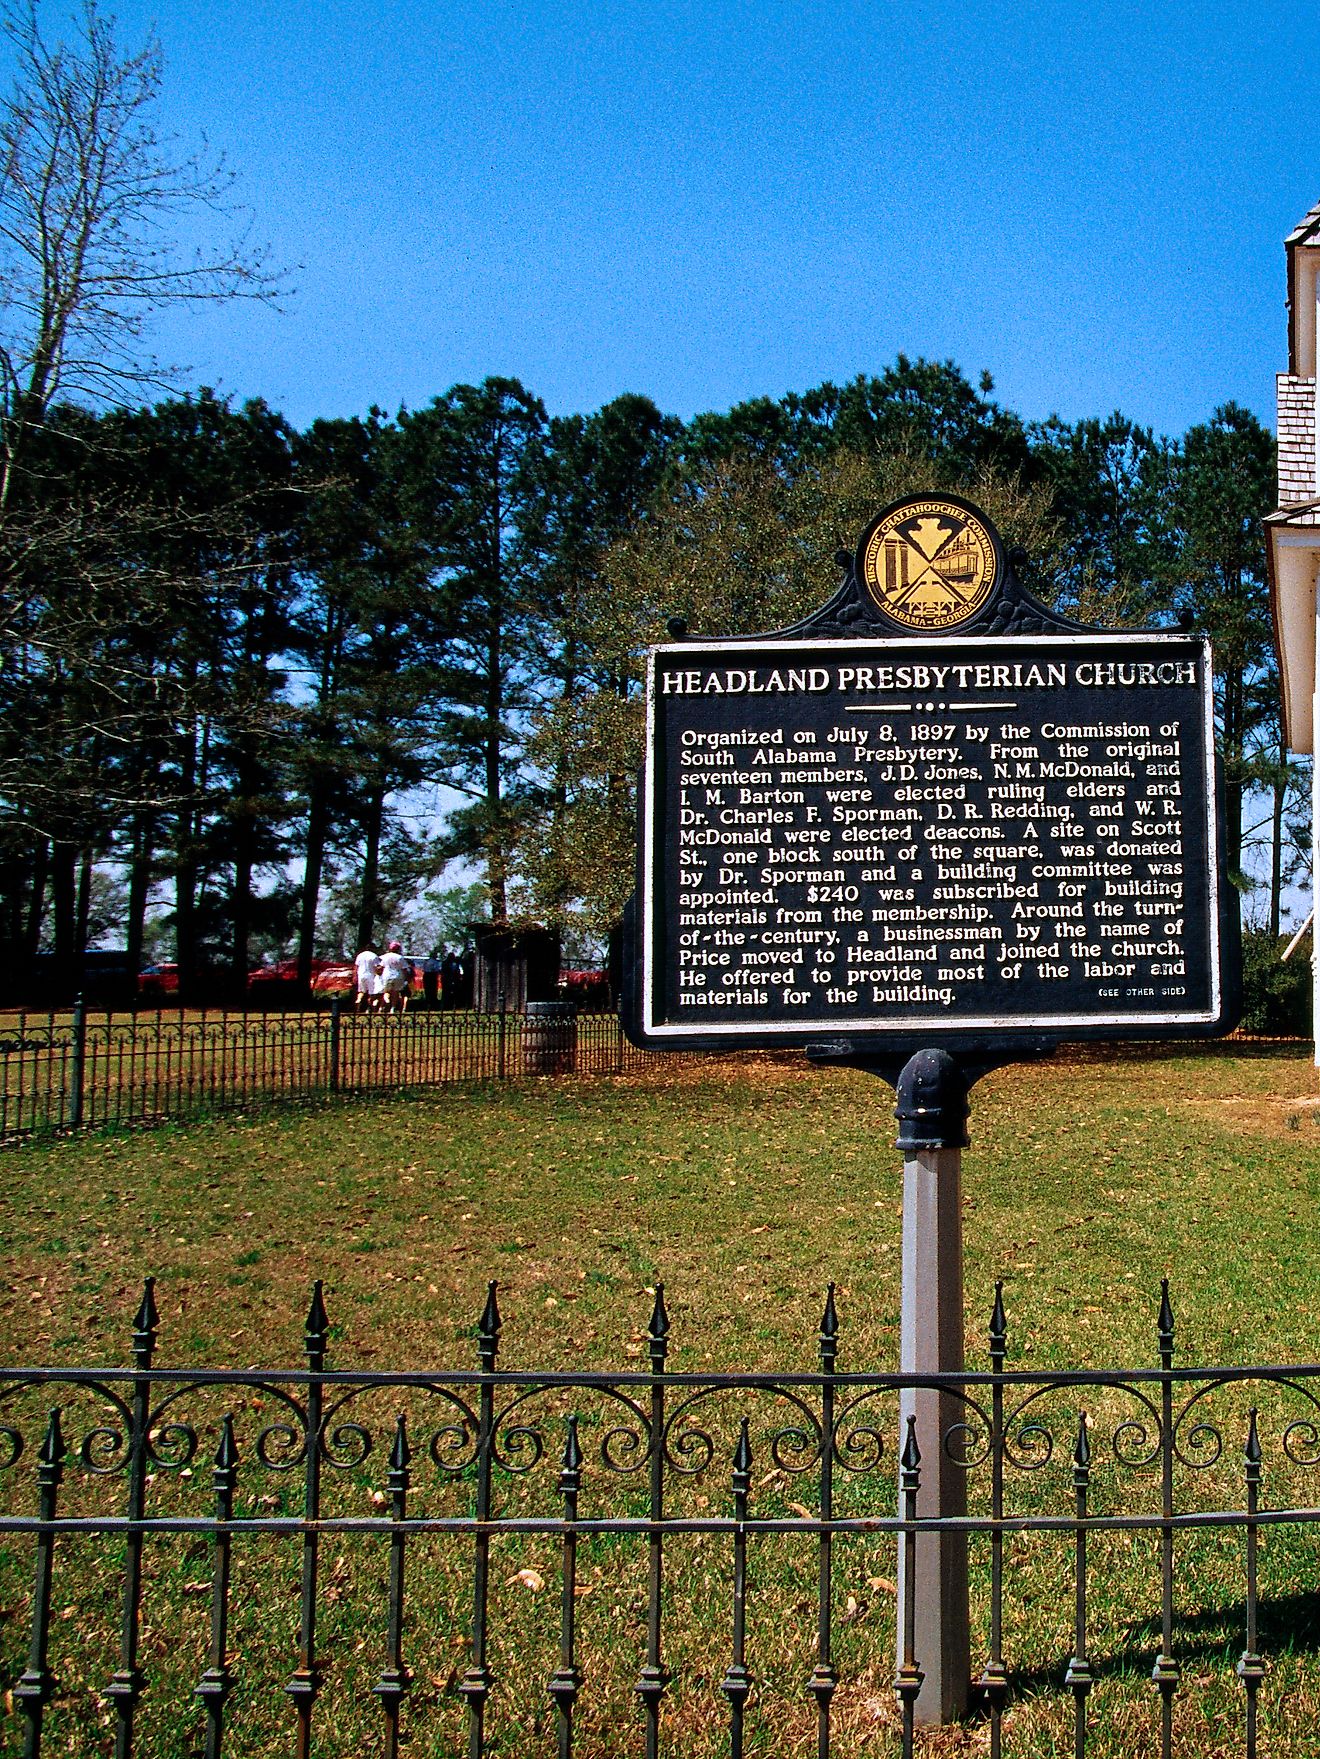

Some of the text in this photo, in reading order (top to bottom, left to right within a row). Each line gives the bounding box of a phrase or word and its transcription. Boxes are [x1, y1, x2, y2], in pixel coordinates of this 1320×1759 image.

[866, 504, 996, 584] HISTORIC CHATTAHOOCHEE COMMISSION
[662, 663, 1196, 693] HEADLAND PRESBYTERIAN CHURCH
[681, 722, 1179, 749] Organized on July 8, 1897 by the Commission of
[681, 741, 1180, 765] South Alabama Presbytery. From the original
[680, 770, 772, 785] seventeen
[780, 767, 867, 783] members,
[924, 765, 982, 780] Jones,
[1040, 761, 1135, 778] McDonald,
[1145, 761, 1180, 775] and
[681, 790, 690, 805] I.
[740, 788, 804, 804] Barton
[826, 790, 872, 802] were
[894, 784, 965, 801] elected
[988, 783, 1045, 802] ruling
[1067, 782, 1125, 797] elders
[1147, 781, 1181, 795] and
[681, 809, 709, 825] Dr.
[720, 809, 793, 824] Charles
[806, 807, 821, 822] F.
[833, 806, 922, 825] Sporman,
[964, 804, 983, 818] R.
[991, 803, 1074, 821] Redding,
[1089, 801, 1123, 816] and
[1135, 801, 1155, 815] W.
[1163, 800, 1181, 815] R.
[680, 821, 1181, 845] McDonald were elected deacons. A site on Scott
[680, 840, 1182, 866] St., one block south of the square, was donated
[680, 861, 1182, 887] by Dr. Sporman and a building committee was
[680, 880, 1183, 908] appointed. $240 was subscribed for building
[680, 901, 1183, 925] materials from the membership. Around the turn-
[857, 931, 869, 941] a
[884, 925, 1002, 941] businessman
[1016, 923, 1040, 941] by
[1054, 922, 1086, 937] the
[1100, 923, 1150, 936] name
[1164, 919, 1183, 934] of
[680, 940, 1184, 965] Price moved to Headland and joined the church.
[680, 960, 1185, 986] He offered to provide most of the labor and
[680, 985, 955, 1005] materials for the building.
[1098, 986, 1186, 997] (SEE OTHER SIDE)
